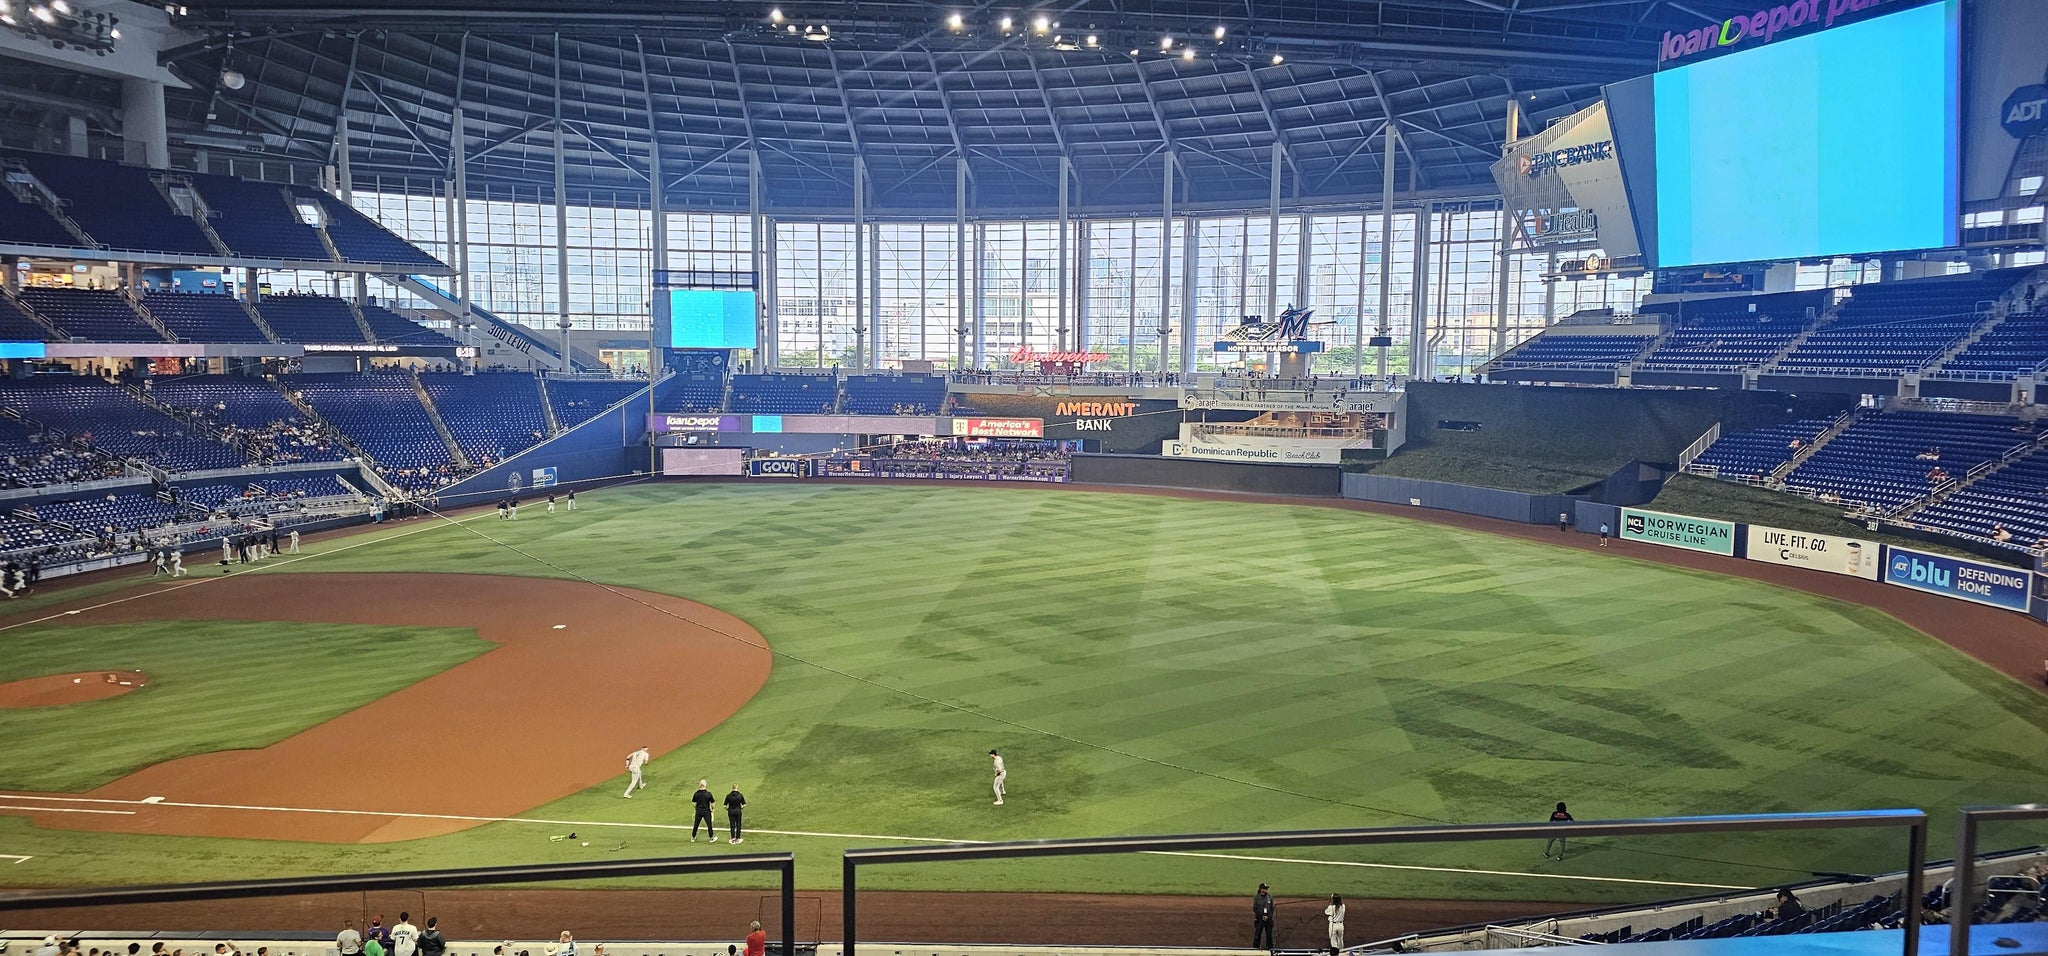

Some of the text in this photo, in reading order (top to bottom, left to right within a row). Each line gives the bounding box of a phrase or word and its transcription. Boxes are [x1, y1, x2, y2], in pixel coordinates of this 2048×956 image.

[1661, 0, 1820, 62] loanDepot
[2005, 99, 2048, 124] ADT
[488, 324, 531, 355] 300 LEVEL
[1009, 345, 1109, 363] Budweiser
[1055, 402, 1136, 417] AMERANT
[1349, 400, 1374, 413] arajet
[666, 416, 720, 427] loanDepot
[980, 420, 1030, 429] America's
[1076, 419, 1112, 431] BANK
[971, 428, 1038, 437] Best Network
[762, 461, 796, 473] GOYA
[1627, 517, 1643, 528] NCL
[1648, 518, 1728, 538] NORWEGIAN
[1647, 529, 1706, 545] CRUISE LINE
[1764, 531, 1827, 552] LIVE. FIT. GO.
[1789, 552, 1809, 560] CELSIUS
[1894, 562, 1908, 572] ADT
[1910, 558, 1950, 587] blu
[1958, 567, 2024, 589] DEFENDING
[1957, 580, 1992, 596] HOME
[400, 936, 405, 945] 7
